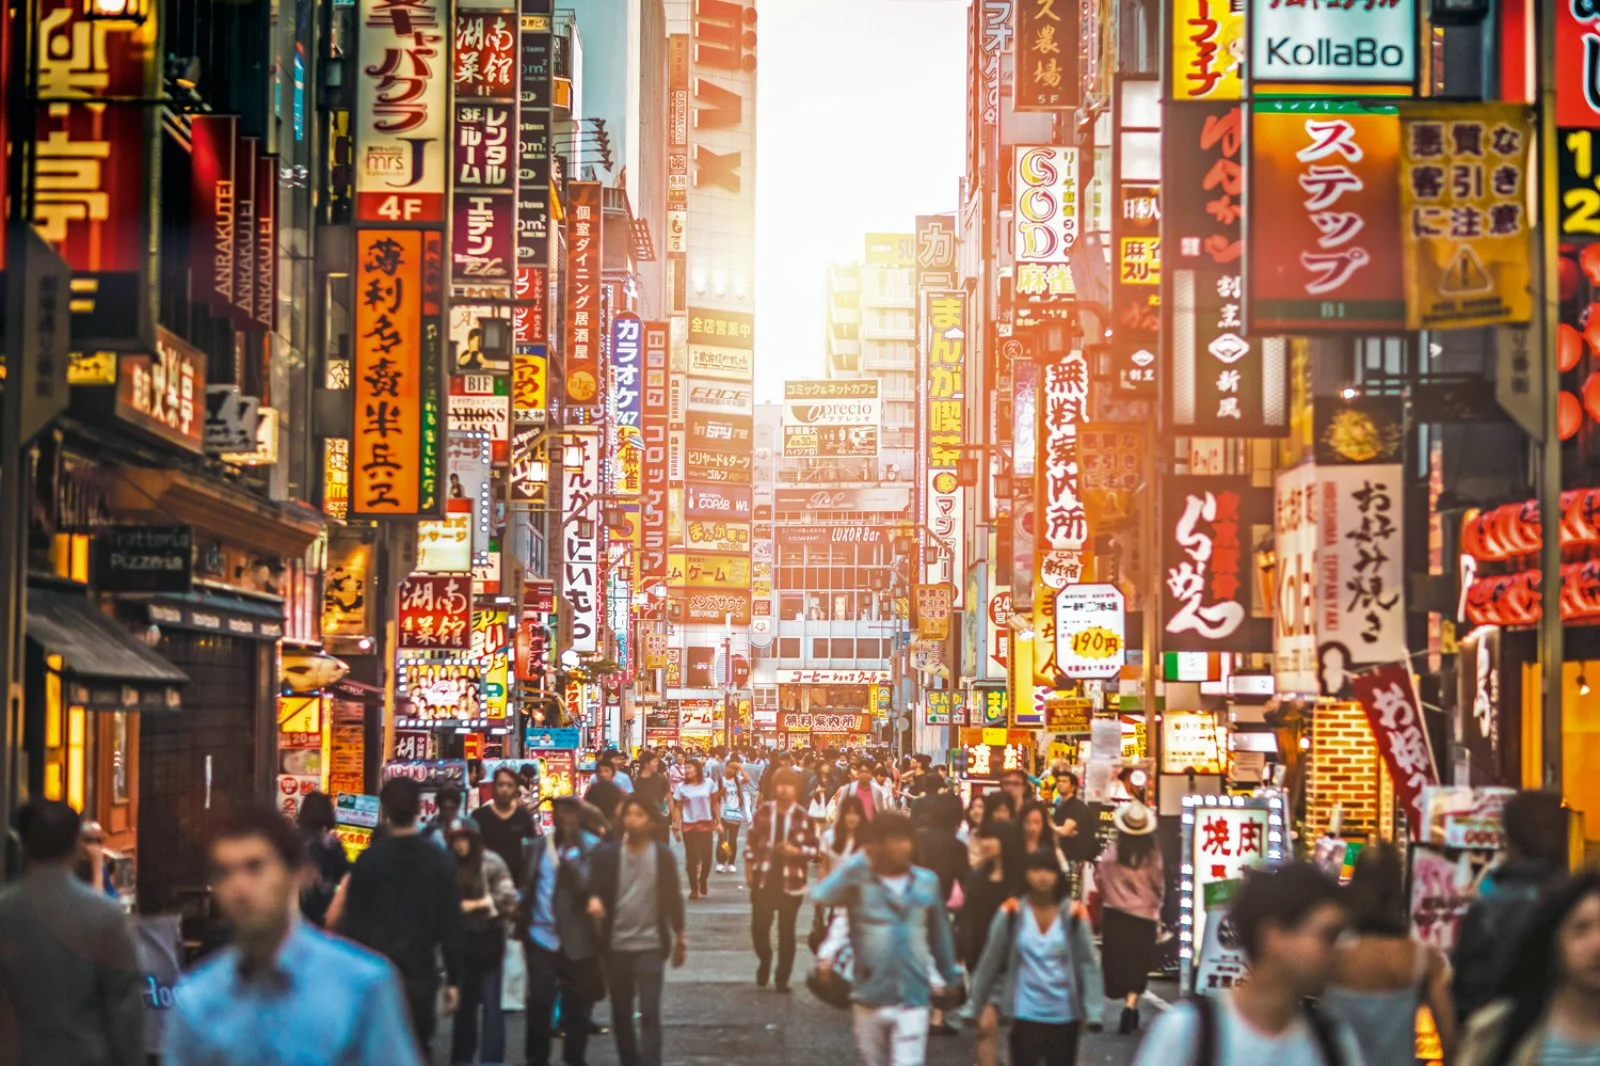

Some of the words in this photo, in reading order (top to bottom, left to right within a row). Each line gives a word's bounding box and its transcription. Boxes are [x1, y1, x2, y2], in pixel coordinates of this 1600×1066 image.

[456, 17, 514, 51] 湖南
[1266, 37, 1404, 67] KollaBo
[460, 126, 482, 184] ルーム
[485, 108, 507, 184] レンタル
[1411, 121, 1520, 157] 悪質な
[384, 137, 438, 188] J
[1411, 164, 1519, 198] 客引き
[377, 194, 423, 221] 4F
[1019, 147, 1058, 258] GOD
[1296, 119, 1369, 295] ステップ
[467, 197, 494, 255] エデン
[1411, 205, 1520, 238] に注意
[214, 180, 233, 304] ANRAKUTEI
[235, 199, 254, 319] ANRAKUTEI
[256, 216, 275, 328] ANRAKUTEI
[574, 205, 592, 360] 個室ダイニング居酒屋
[1016, 263, 1075, 294] 麻雀
[691, 317, 751, 338] 全店営業中
[616, 319, 639, 409] カラオケ
[467, 376, 490, 391] BIF
[691, 387, 750, 400] FACE
[930, 298, 962, 467] まんが喫茶
[617, 410, 638, 425] 747
[625, 447, 638, 489] 麻雀
[1048, 361, 1085, 542] 無料案内所
[832, 527, 863, 542] LUXOR
[864, 527, 880, 541] Bar
[688, 565, 726, 581] ゲーム
[400, 579, 467, 614] 湖南
[690, 595, 745, 608] メンズサウナ
[415, 615, 467, 647] 菜館
[1073, 632, 1118, 652] 190円
[791, 671, 830, 683] コーヒー
[857, 671, 877, 683] クール
[682, 713, 711, 724] ゲーム
[784, 713, 855, 728] 無料案内所
